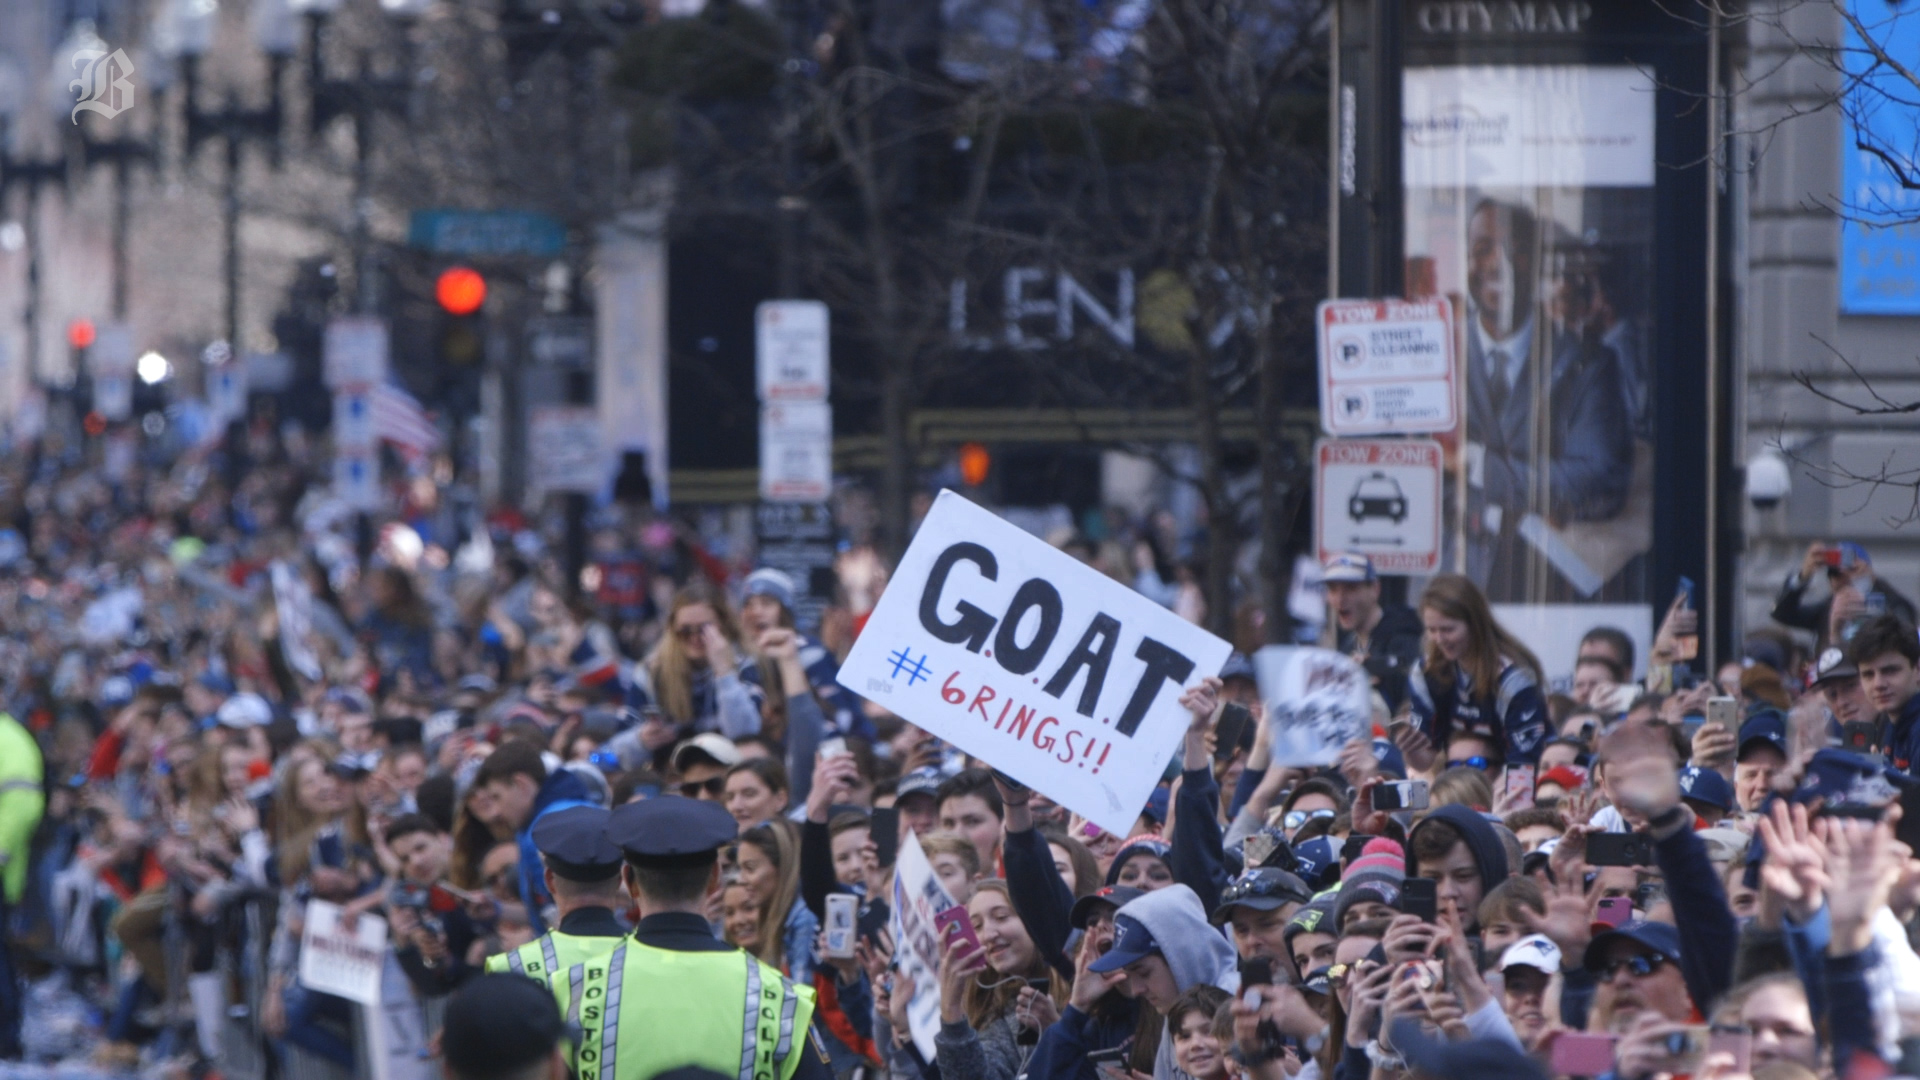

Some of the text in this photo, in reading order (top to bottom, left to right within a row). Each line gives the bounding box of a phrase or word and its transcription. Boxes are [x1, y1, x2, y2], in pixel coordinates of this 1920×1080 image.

[1417, 2, 1592, 32] CITY MAP
[1334, 302, 1438, 323] TOW ZONE
[1371, 328, 1424, 342] STREET
[1371, 343, 1440, 357] CLEANING
[1330, 447, 1431, 465] TOW ZONE
[580, 967, 604, 1080] BOSTON
